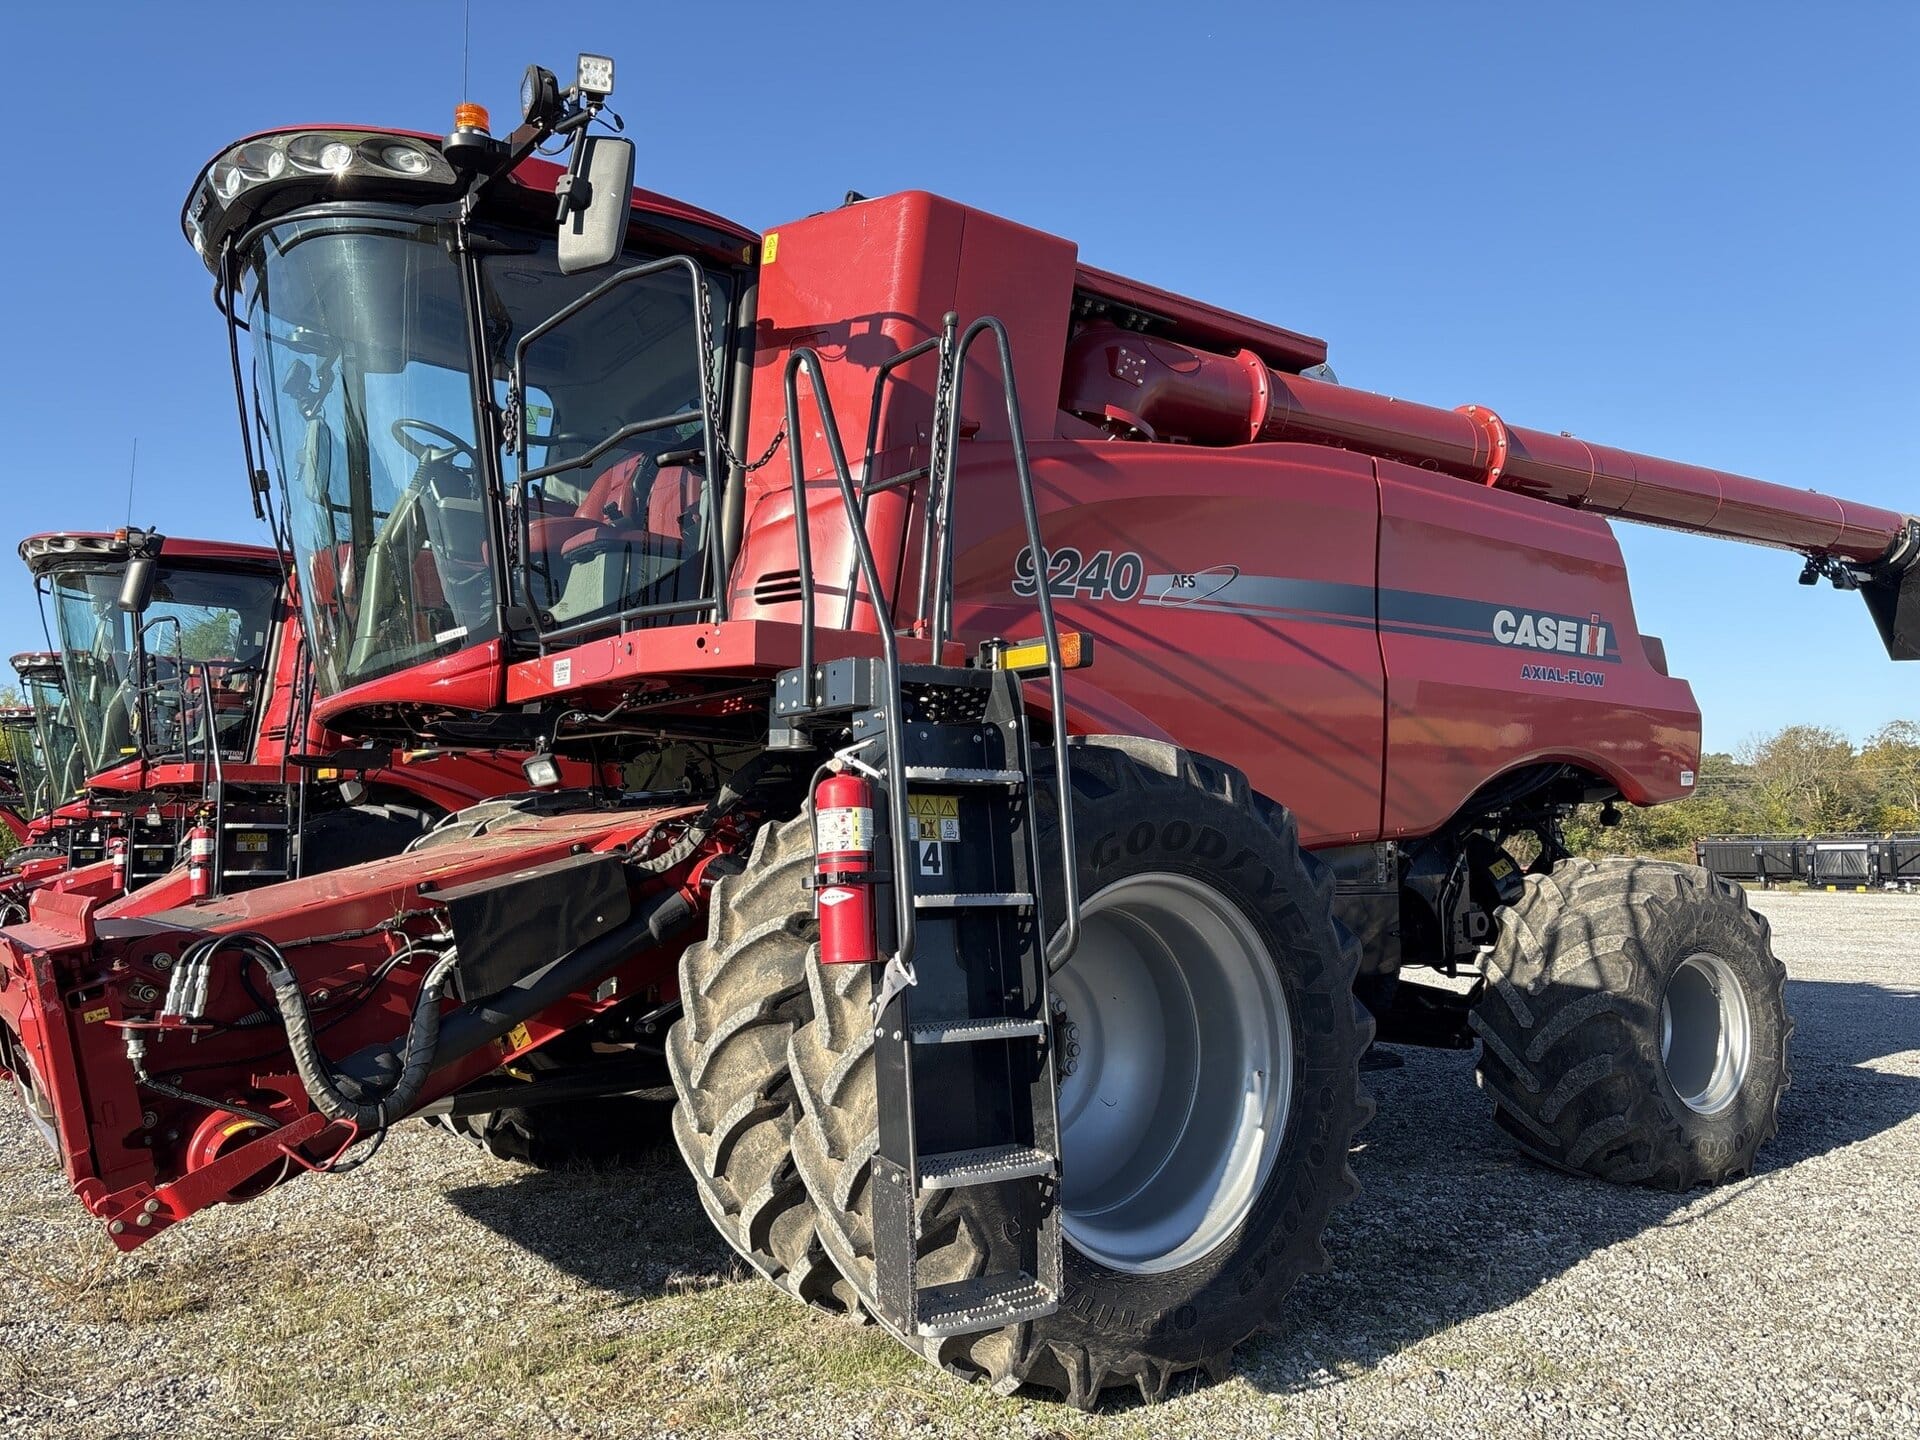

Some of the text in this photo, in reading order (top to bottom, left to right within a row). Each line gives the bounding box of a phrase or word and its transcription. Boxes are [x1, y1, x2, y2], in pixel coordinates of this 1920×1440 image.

[1012, 545, 1143, 600] 9240
[1171, 574, 1195, 588] AFS
[1493, 610, 1577, 652] CASE
[1520, 664, 1605, 687] AXIAL-FLOW
[922, 842, 940, 874] 4
